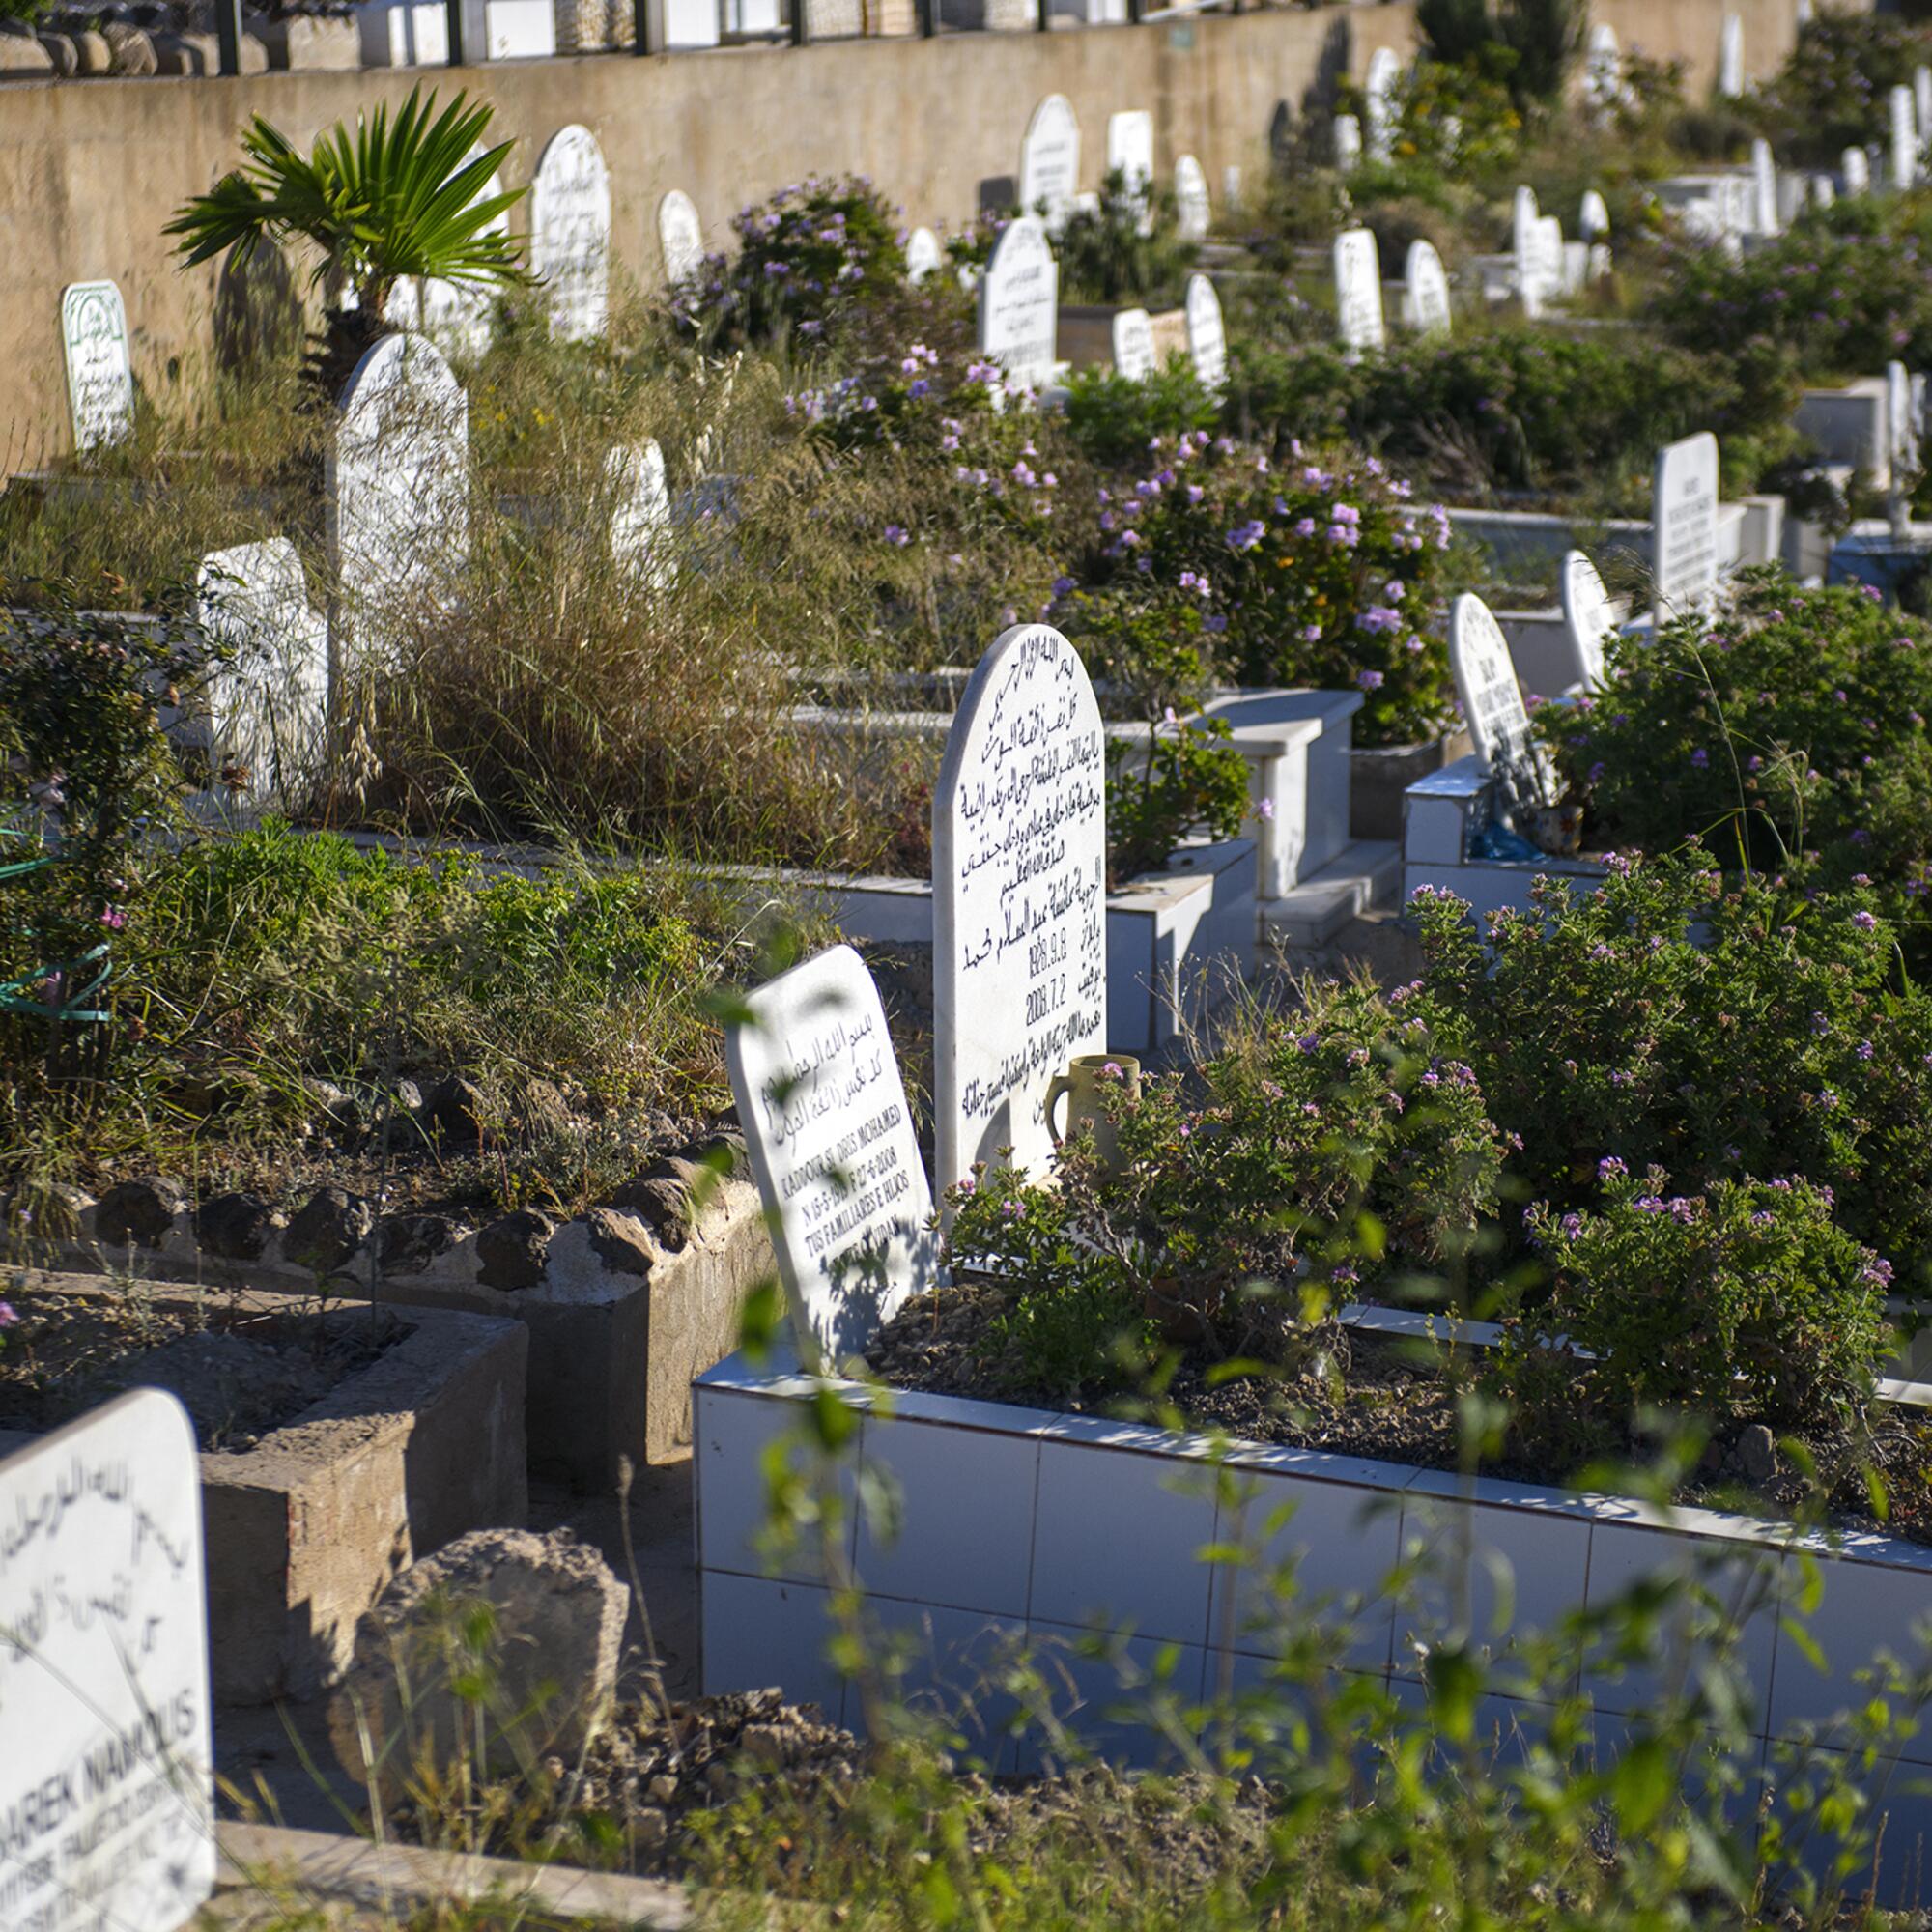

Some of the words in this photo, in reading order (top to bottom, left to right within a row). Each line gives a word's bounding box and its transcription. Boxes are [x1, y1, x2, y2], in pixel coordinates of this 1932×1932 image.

[826, 1021, 848, 1060] الله
[850, 1011, 875, 1064] بسم
[857, 1104, 901, 1149] MOHAMED
[804, 1235, 825, 1258] TUS
[875, 1187, 885, 1208] E
